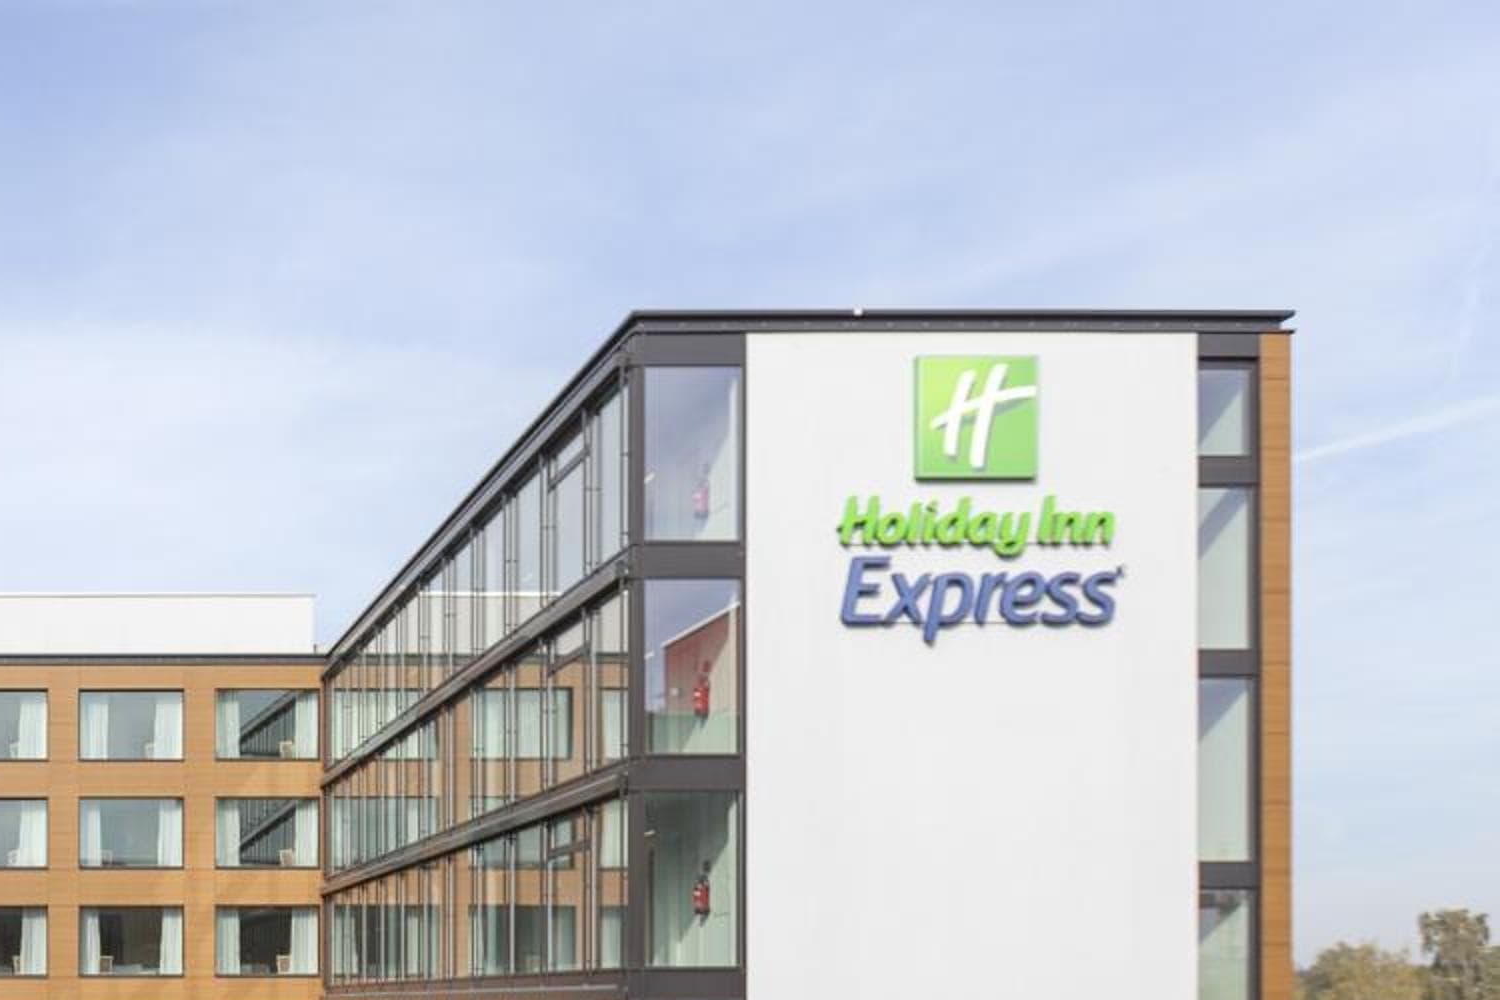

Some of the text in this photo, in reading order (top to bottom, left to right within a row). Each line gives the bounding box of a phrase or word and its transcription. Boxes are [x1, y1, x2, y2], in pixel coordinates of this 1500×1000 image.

[837, 495, 1115, 558] Holiday Inn
[840, 556, 1116, 646] Express
